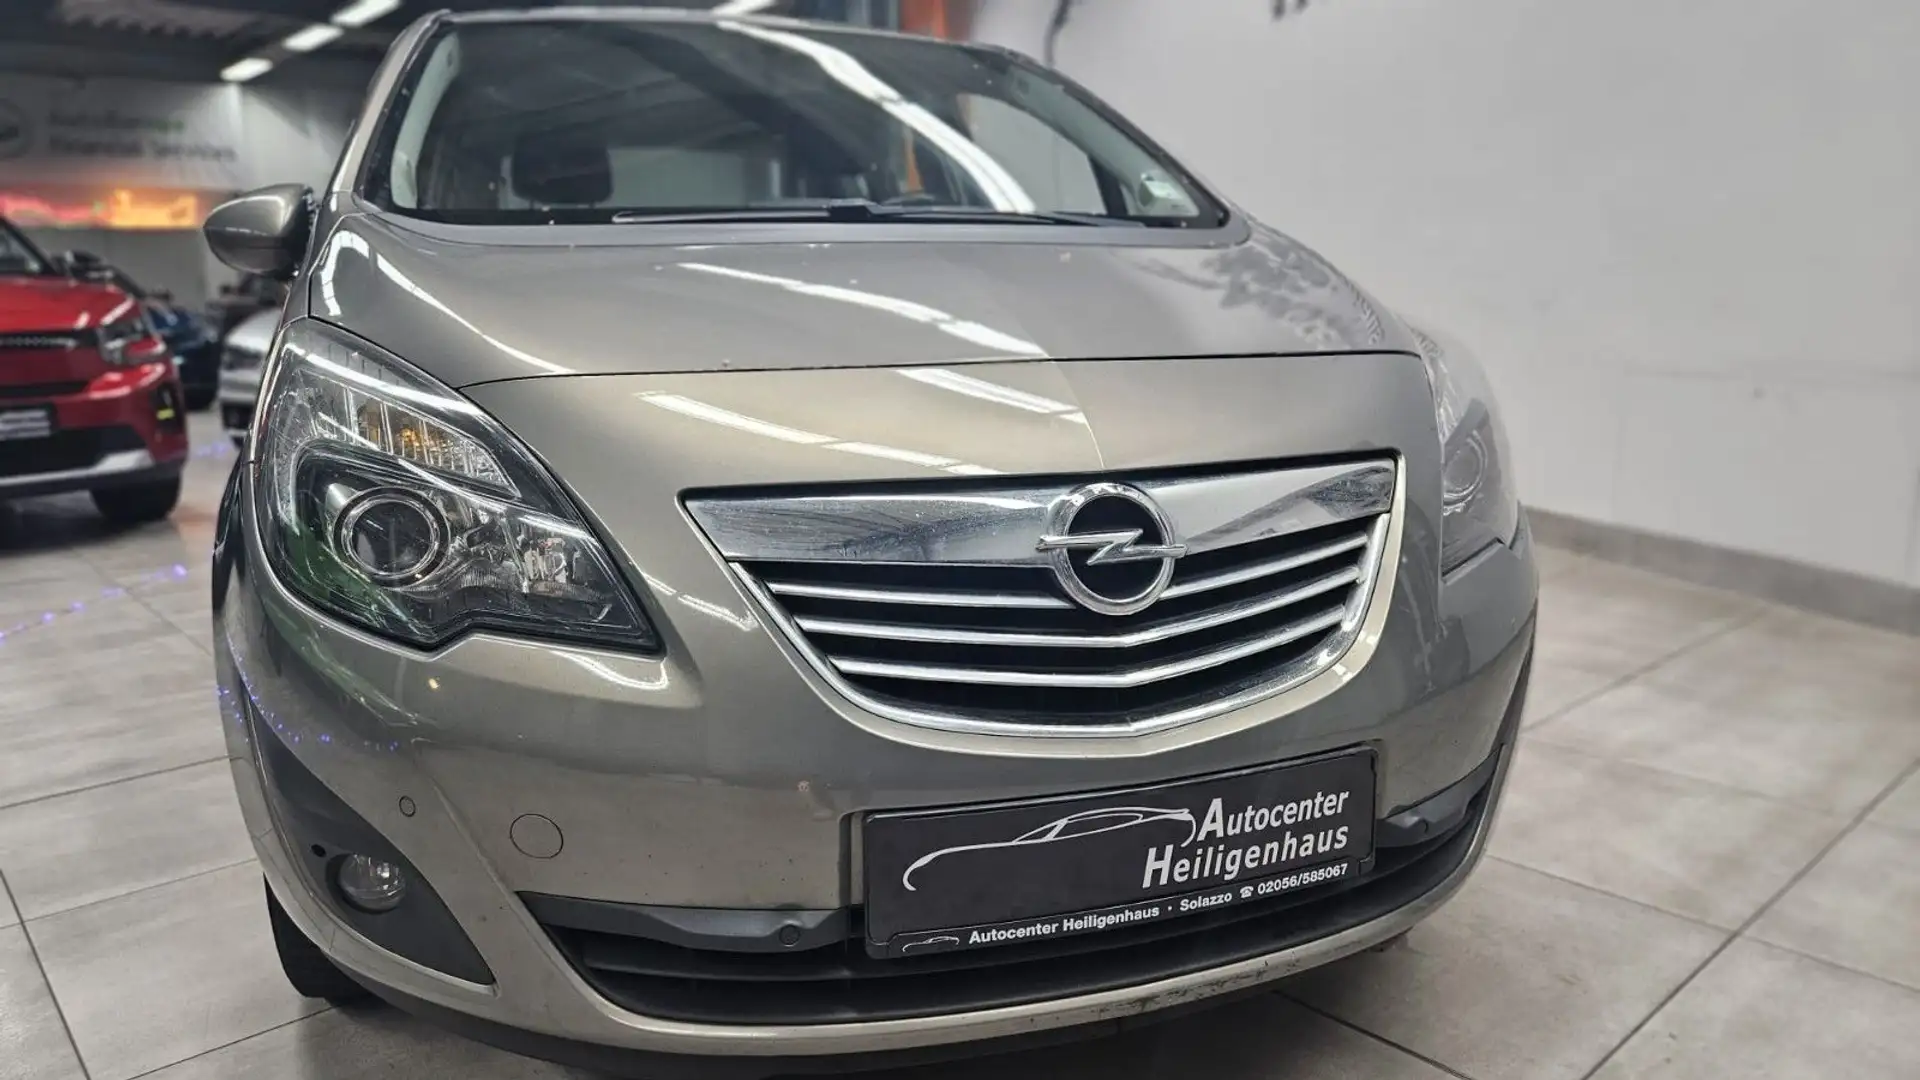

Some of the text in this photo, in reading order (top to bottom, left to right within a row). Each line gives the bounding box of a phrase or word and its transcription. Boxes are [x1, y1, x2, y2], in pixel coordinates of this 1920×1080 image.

[1197, 791, 1350, 842] Autocenter
[1142, 825, 1349, 889] Heiligenhaus
[968, 863, 1348, 944] Autocenter Heiligenhaus Solazzo 02056/585067
